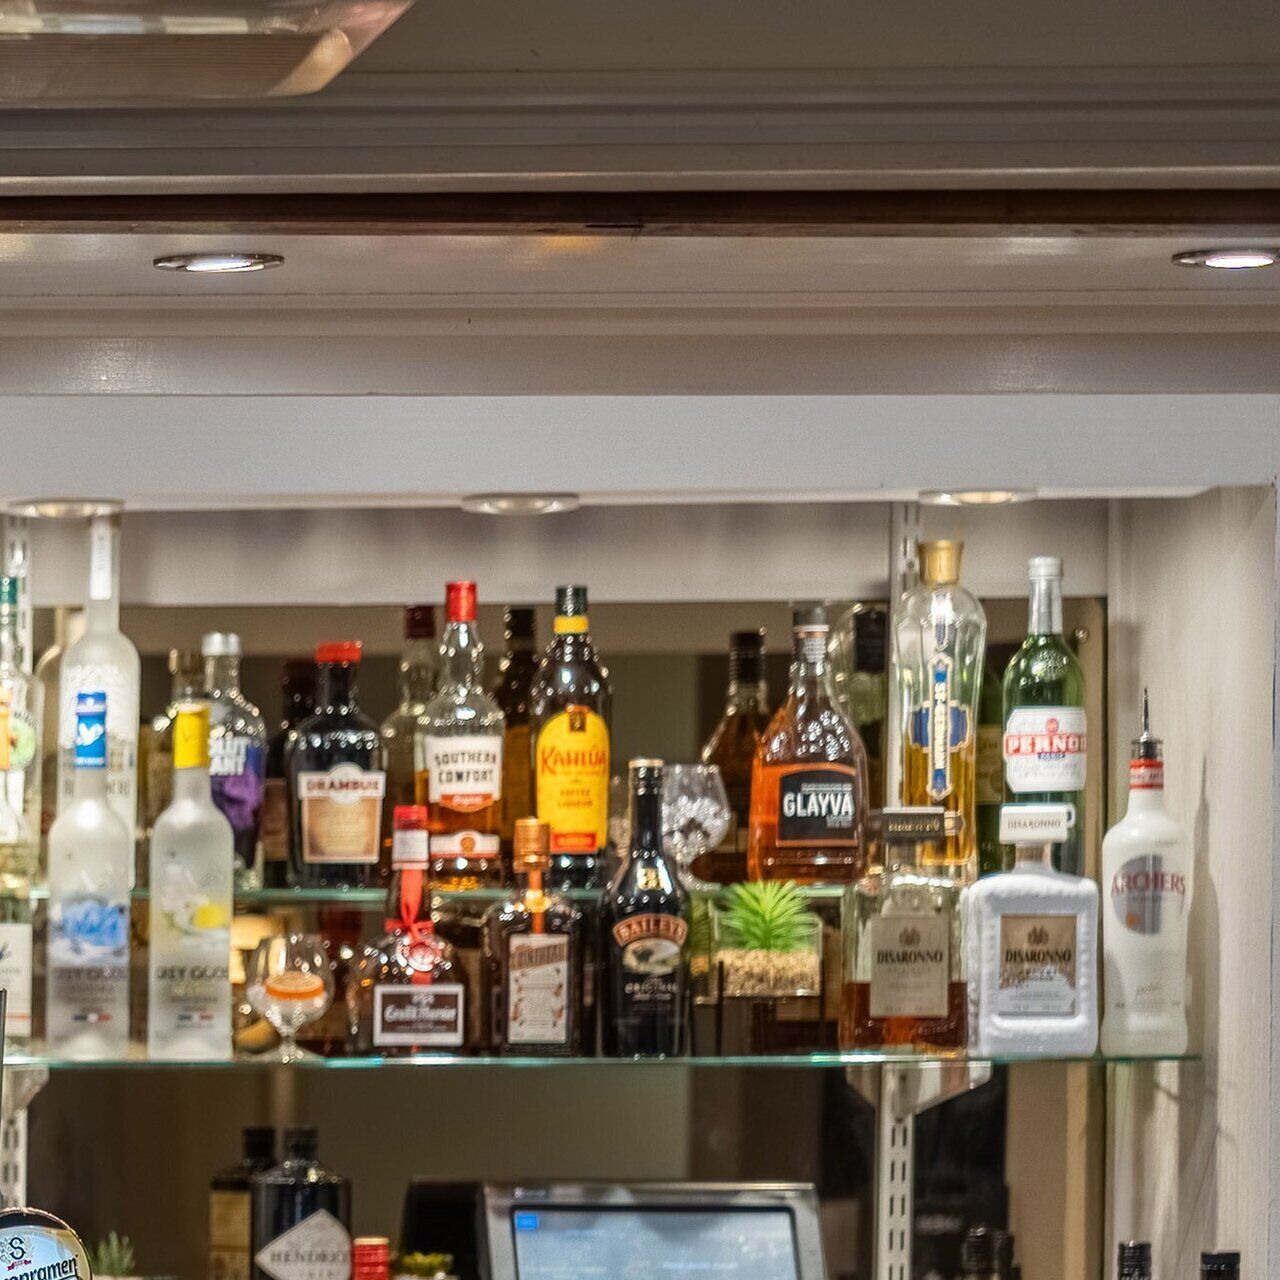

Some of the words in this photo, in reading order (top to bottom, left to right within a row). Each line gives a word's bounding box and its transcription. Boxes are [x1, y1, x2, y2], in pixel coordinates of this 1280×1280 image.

[433, 752, 497, 765] SOUTHERN
[540, 745, 607, 776] KAHLÚA
[438, 769, 494, 783] COMFORT
[782, 790, 855, 818] GLAYVA
[1007, 818, 1061, 830] DISARONNO
[1111, 872, 1187, 896] ARCHERS
[876, 950, 943, 965] DISARONNO
[1005, 950, 1072, 963] DISARONNO
